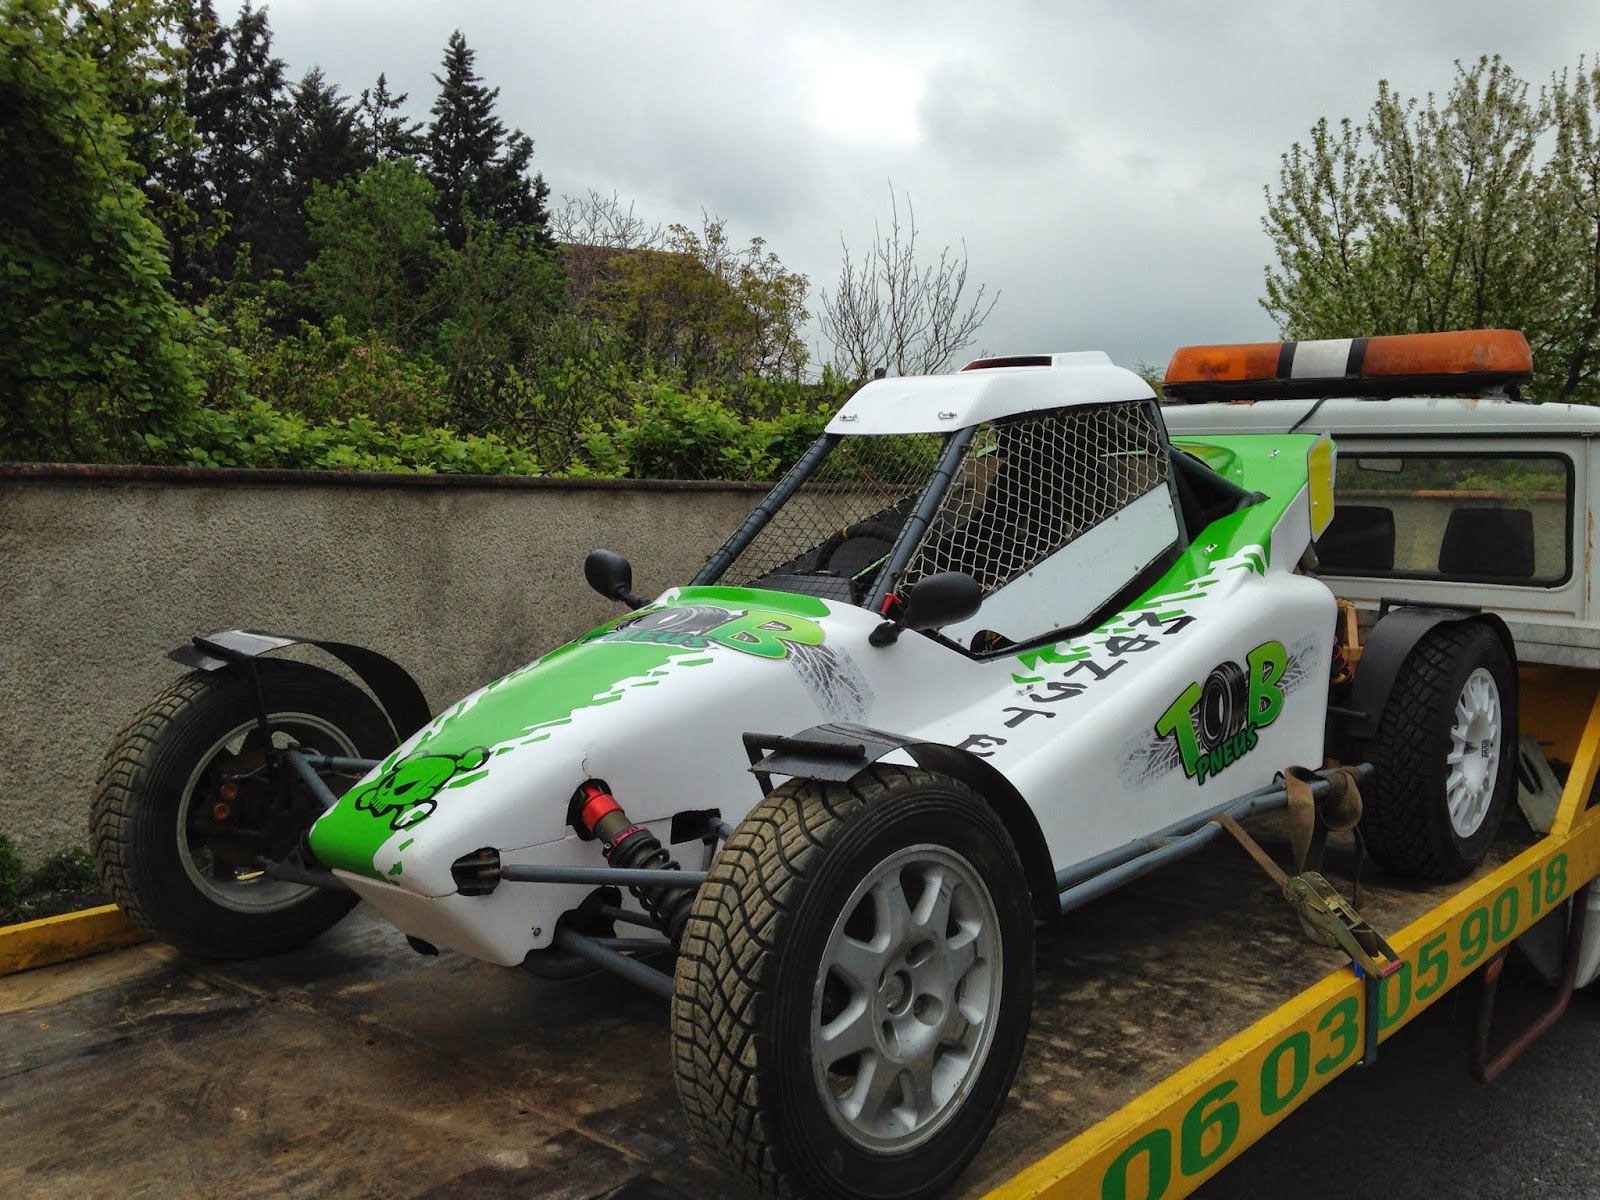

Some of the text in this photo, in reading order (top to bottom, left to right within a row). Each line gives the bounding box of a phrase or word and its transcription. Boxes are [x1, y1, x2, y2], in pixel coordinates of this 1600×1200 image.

[580, 629, 718, 649] NEUS
[1154, 640, 1288, 779] TOB
[1195, 722, 1259, 786] PNEUS
[1102, 852, 1568, 1200] 06 03 05 90 18
